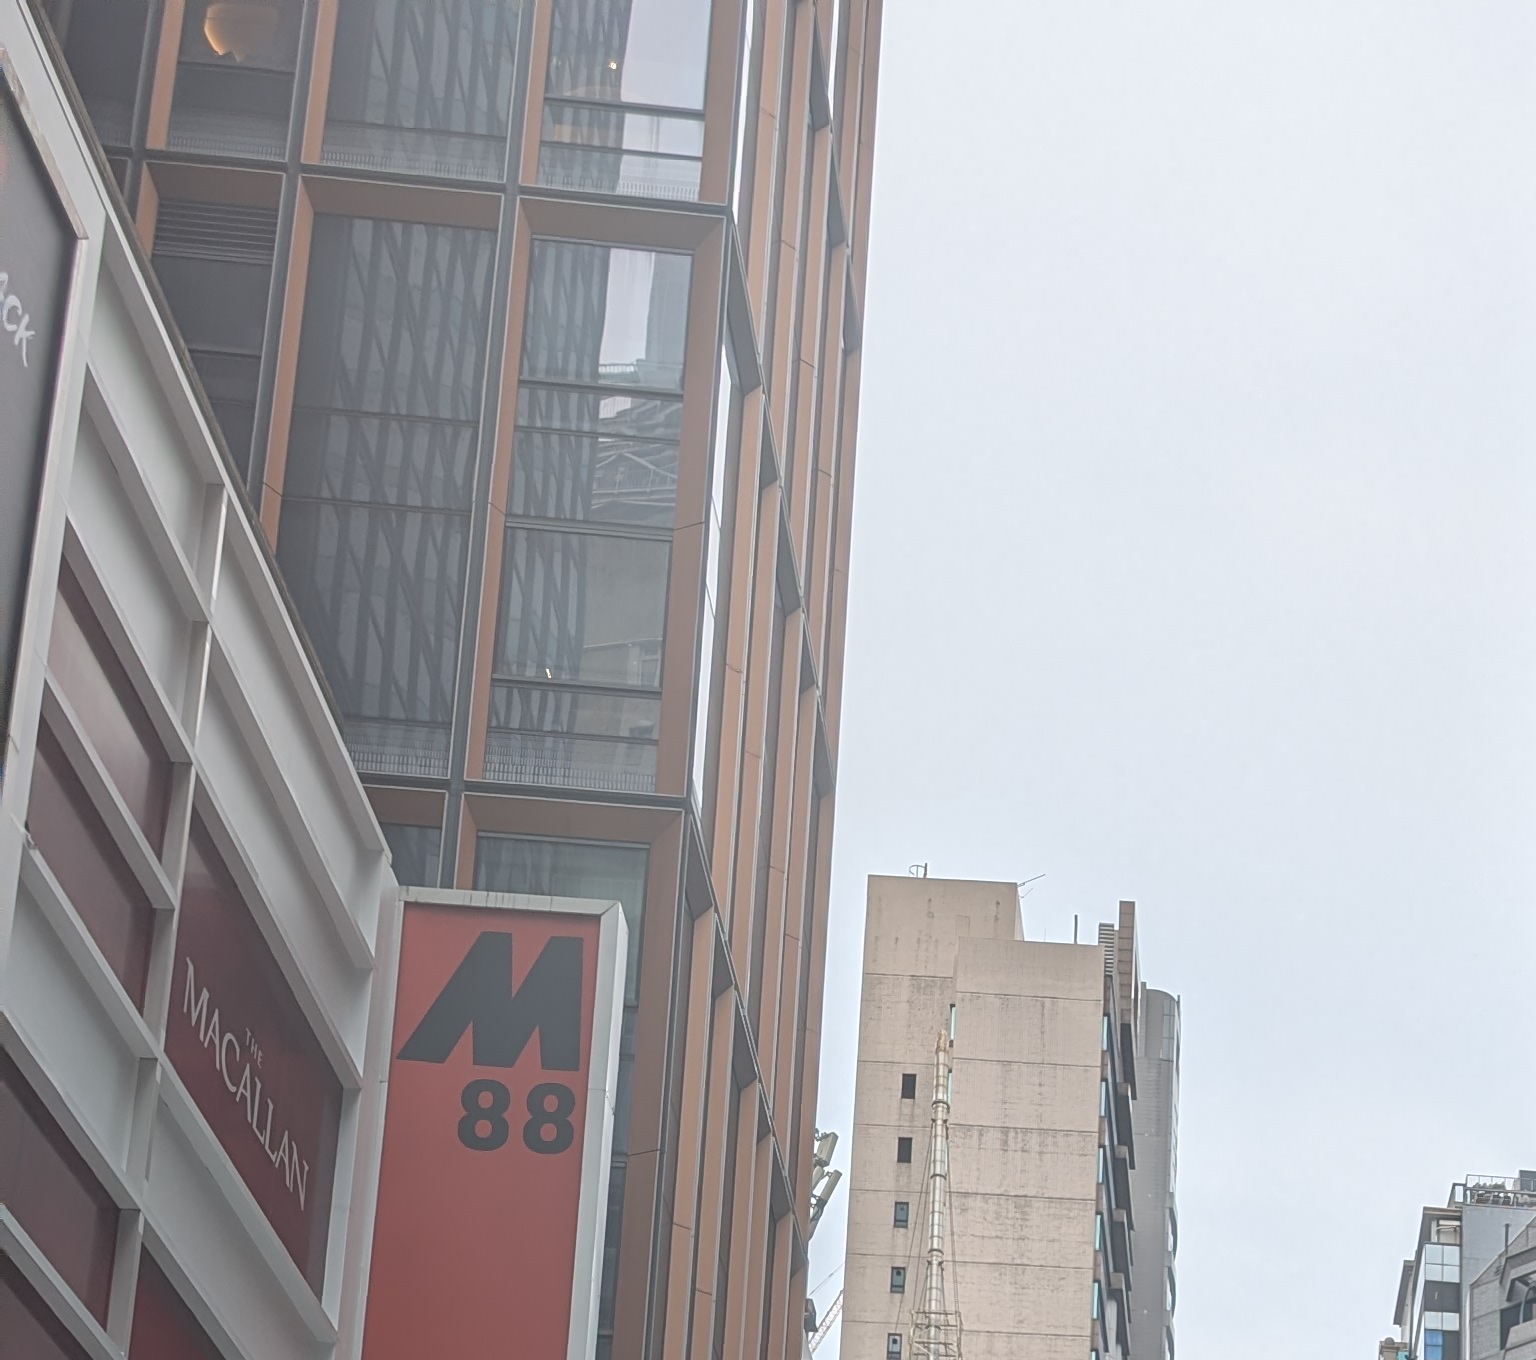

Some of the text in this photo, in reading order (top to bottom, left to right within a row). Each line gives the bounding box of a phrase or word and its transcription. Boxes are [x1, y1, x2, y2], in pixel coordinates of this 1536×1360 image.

[245, 1027, 264, 1069] THE
[396, 931, 584, 1072] M
[184, 957, 309, 1211] MACALLAN
[458, 1079, 576, 1155] 88
